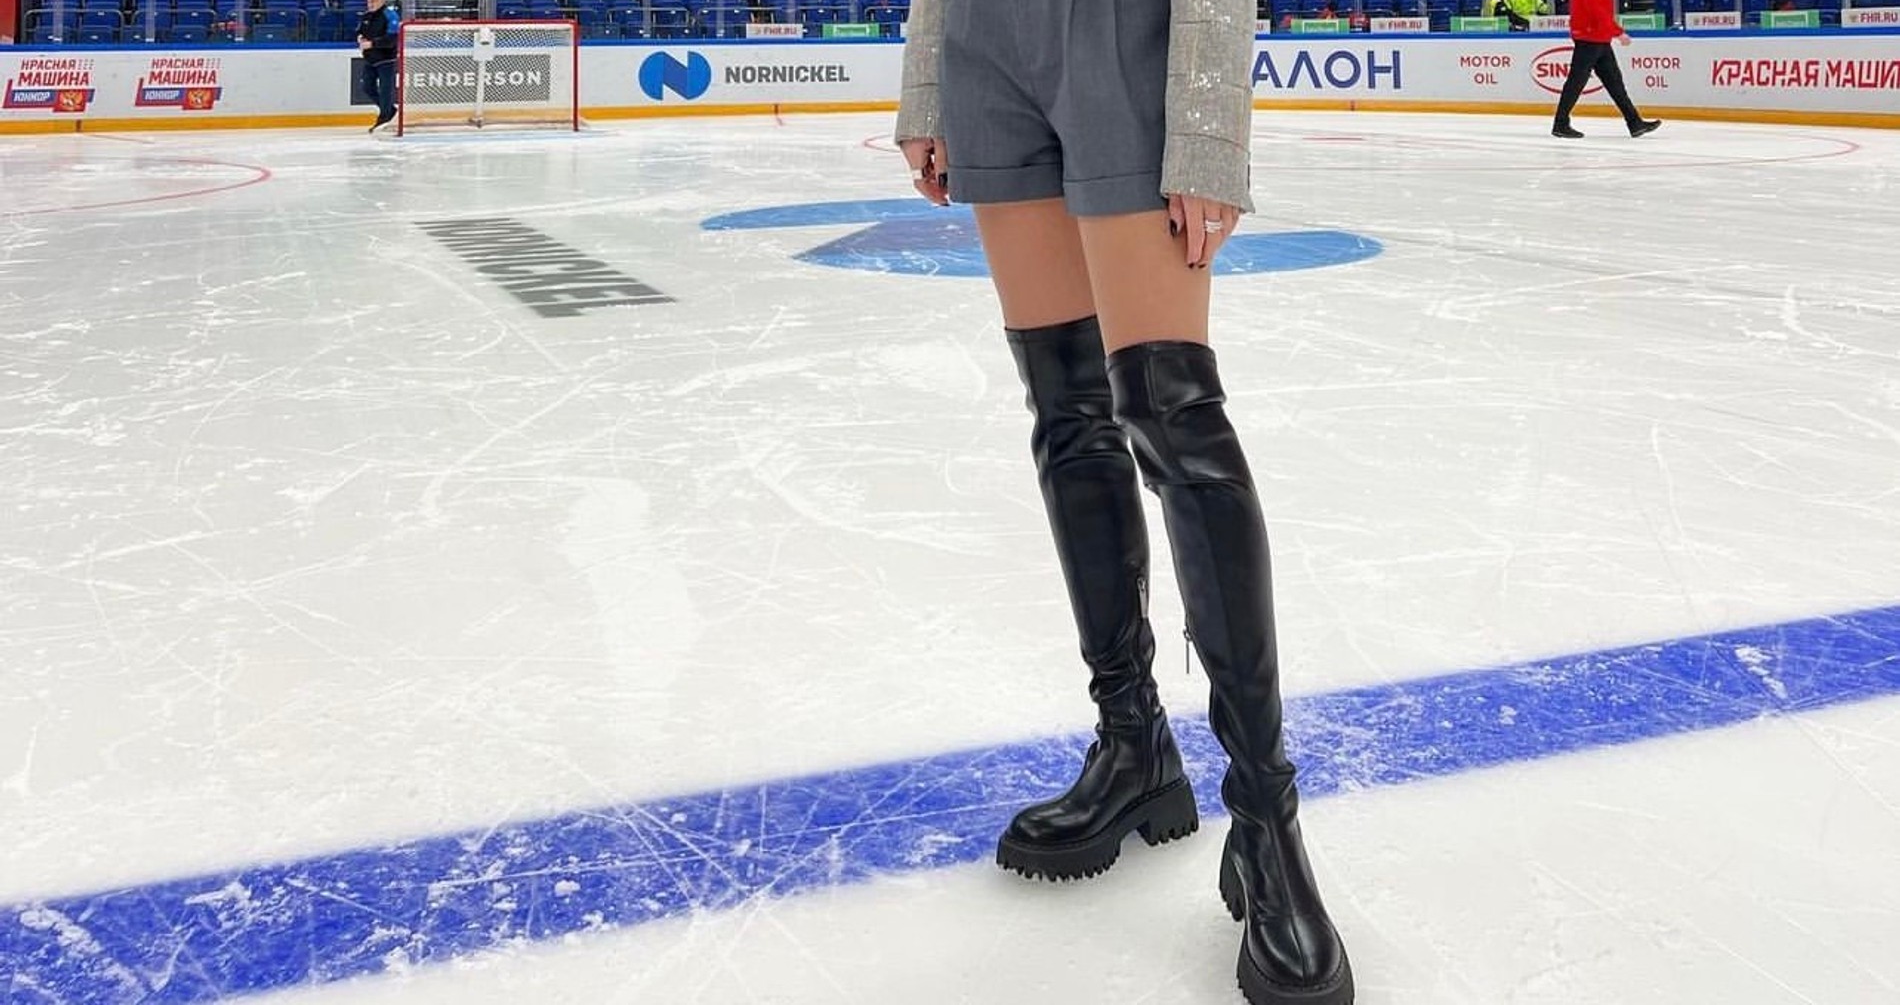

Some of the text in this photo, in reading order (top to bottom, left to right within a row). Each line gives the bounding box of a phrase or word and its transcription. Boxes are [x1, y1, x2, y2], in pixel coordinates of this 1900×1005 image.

[1703, 16, 1735, 25] FHR.RU
[1861, 11, 1898, 22] FHR.RU
[1460, 56, 1511, 68] MOTOR
[1631, 57, 1681, 70] MOTOR
[149, 70, 217, 84] МАШИНА
[725, 66, 850, 84] NORNICKEL
[1536, 63, 1571, 78] SIN
[1712, 60, 1819, 87] КРАСНАЯ
[18, 72, 90, 86] МАШИНА
[1474, 73, 1498, 85] OIL
[1645, 76, 1668, 88] OIL
